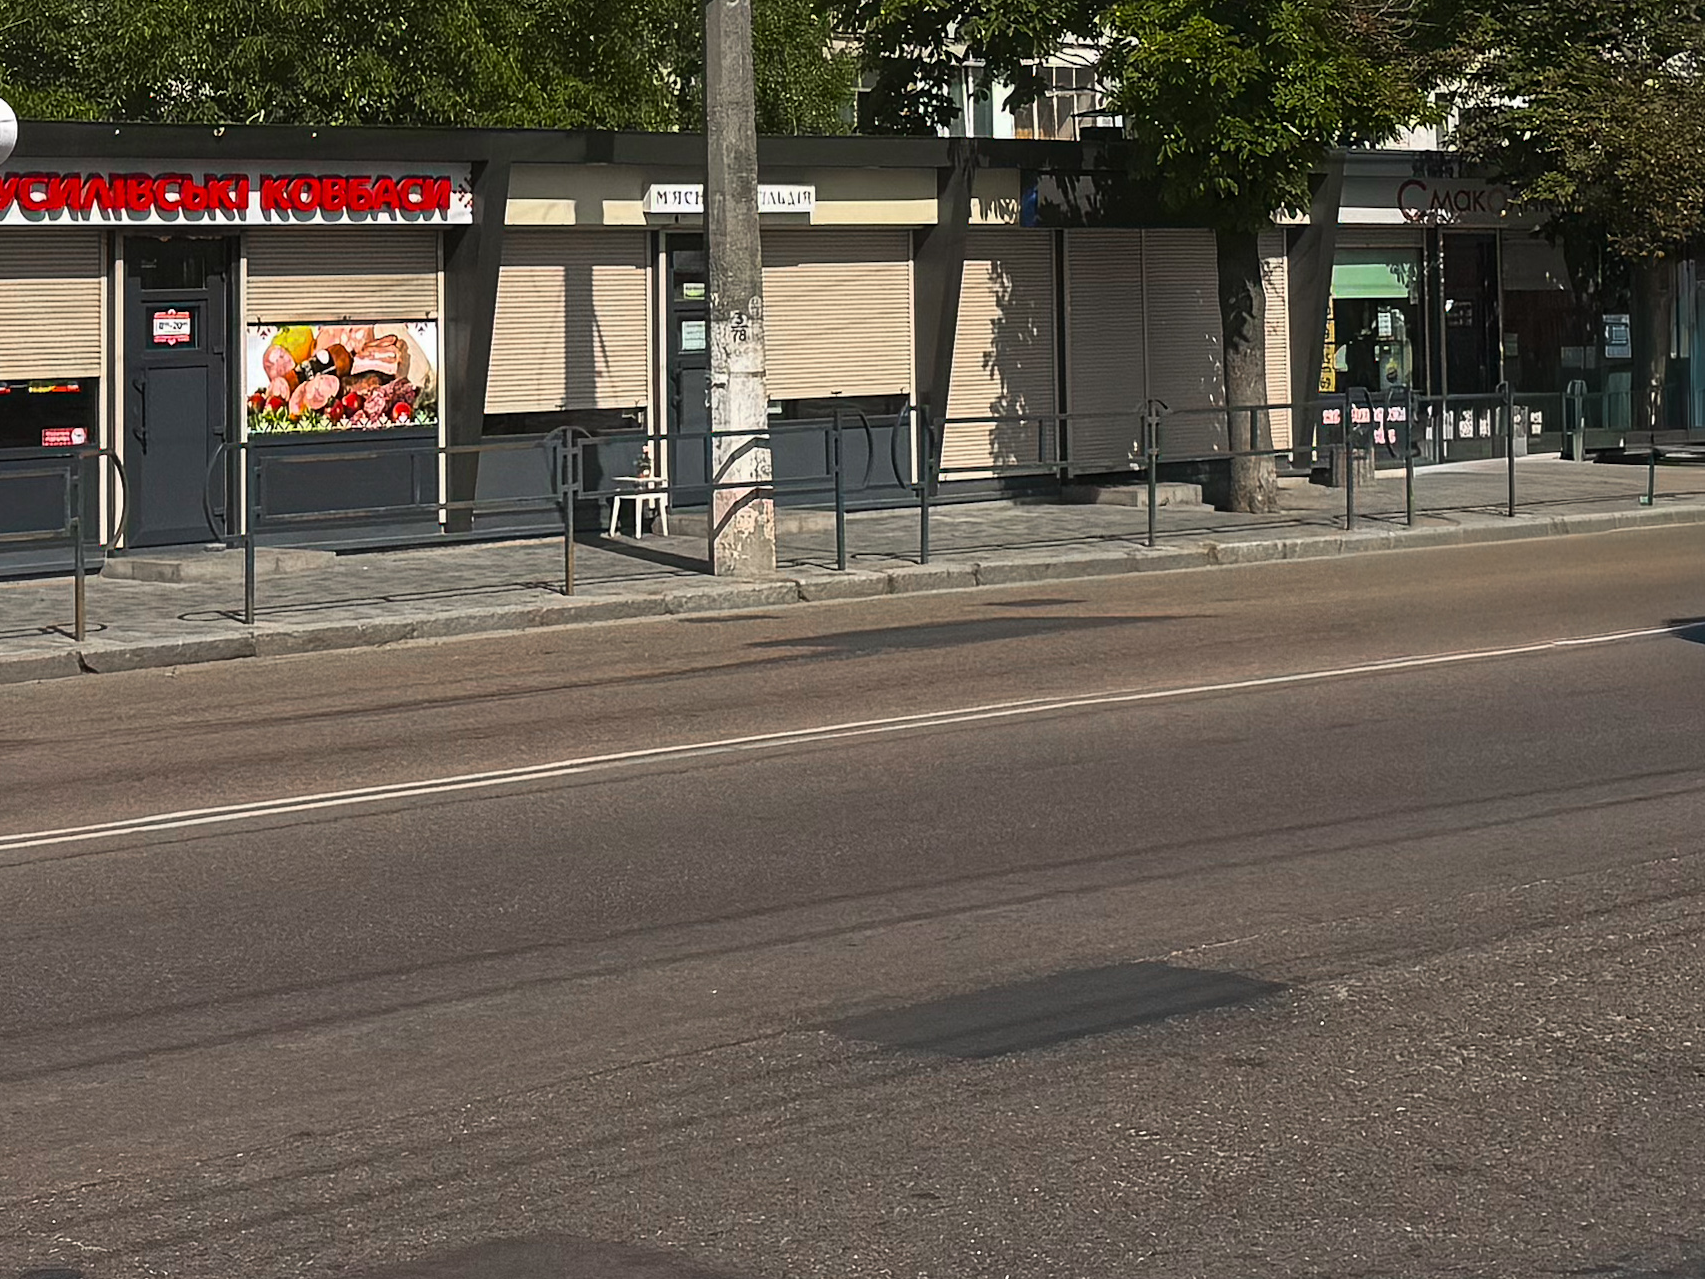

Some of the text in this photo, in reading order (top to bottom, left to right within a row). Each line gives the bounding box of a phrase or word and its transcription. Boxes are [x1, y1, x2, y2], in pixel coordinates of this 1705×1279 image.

[260, 173, 453, 211] КОВБАСИ
[656, 190, 812, 206] М'ЯСН ІЛЬДІЯ
